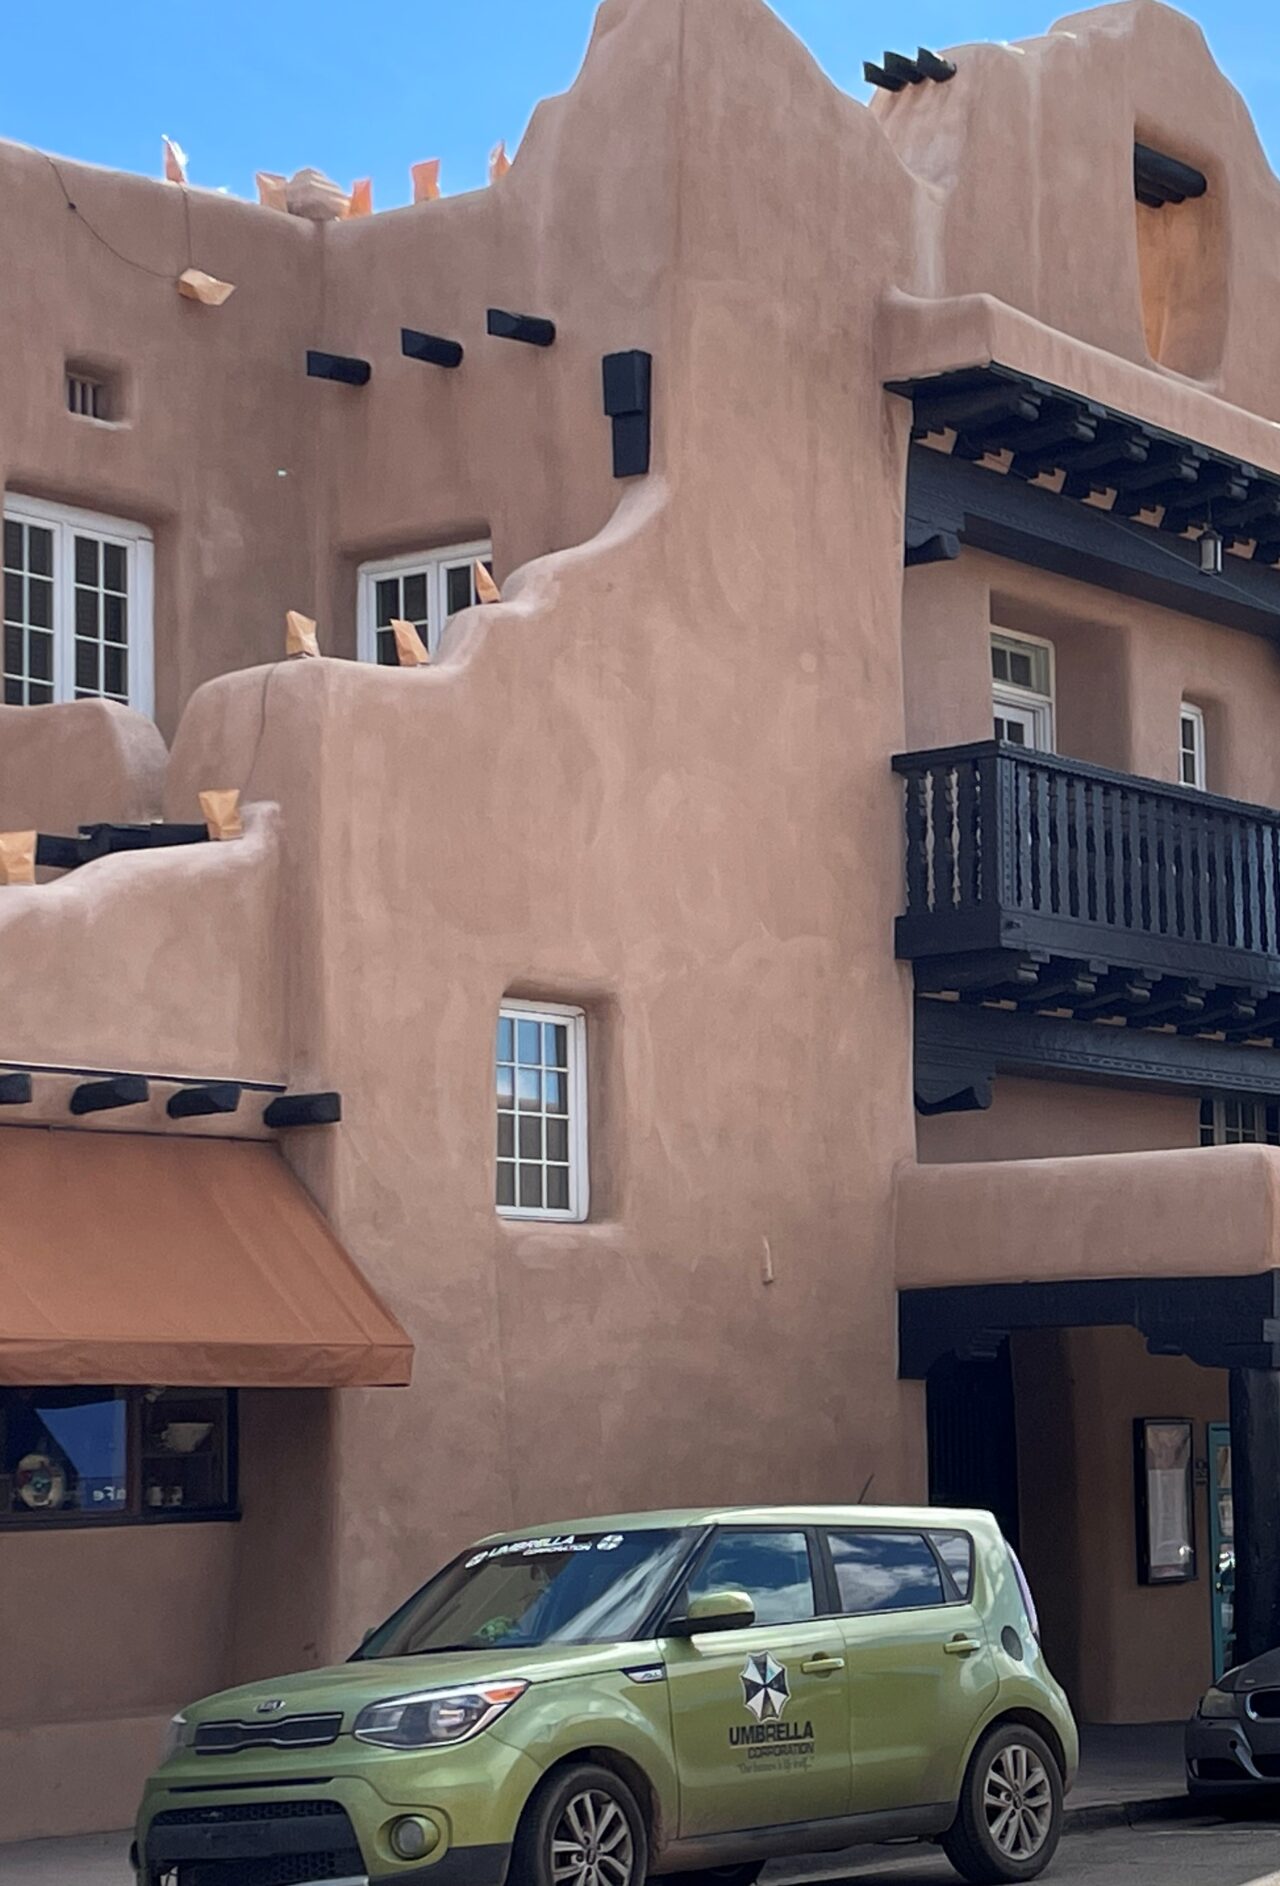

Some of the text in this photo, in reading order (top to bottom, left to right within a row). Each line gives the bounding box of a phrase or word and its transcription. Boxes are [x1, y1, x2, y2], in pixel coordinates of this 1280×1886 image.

[488, 1535, 575, 1558] UMBRELLA
[729, 1721, 814, 1745] UMBRELLA
[748, 1743, 814, 1759] CORPORATION
